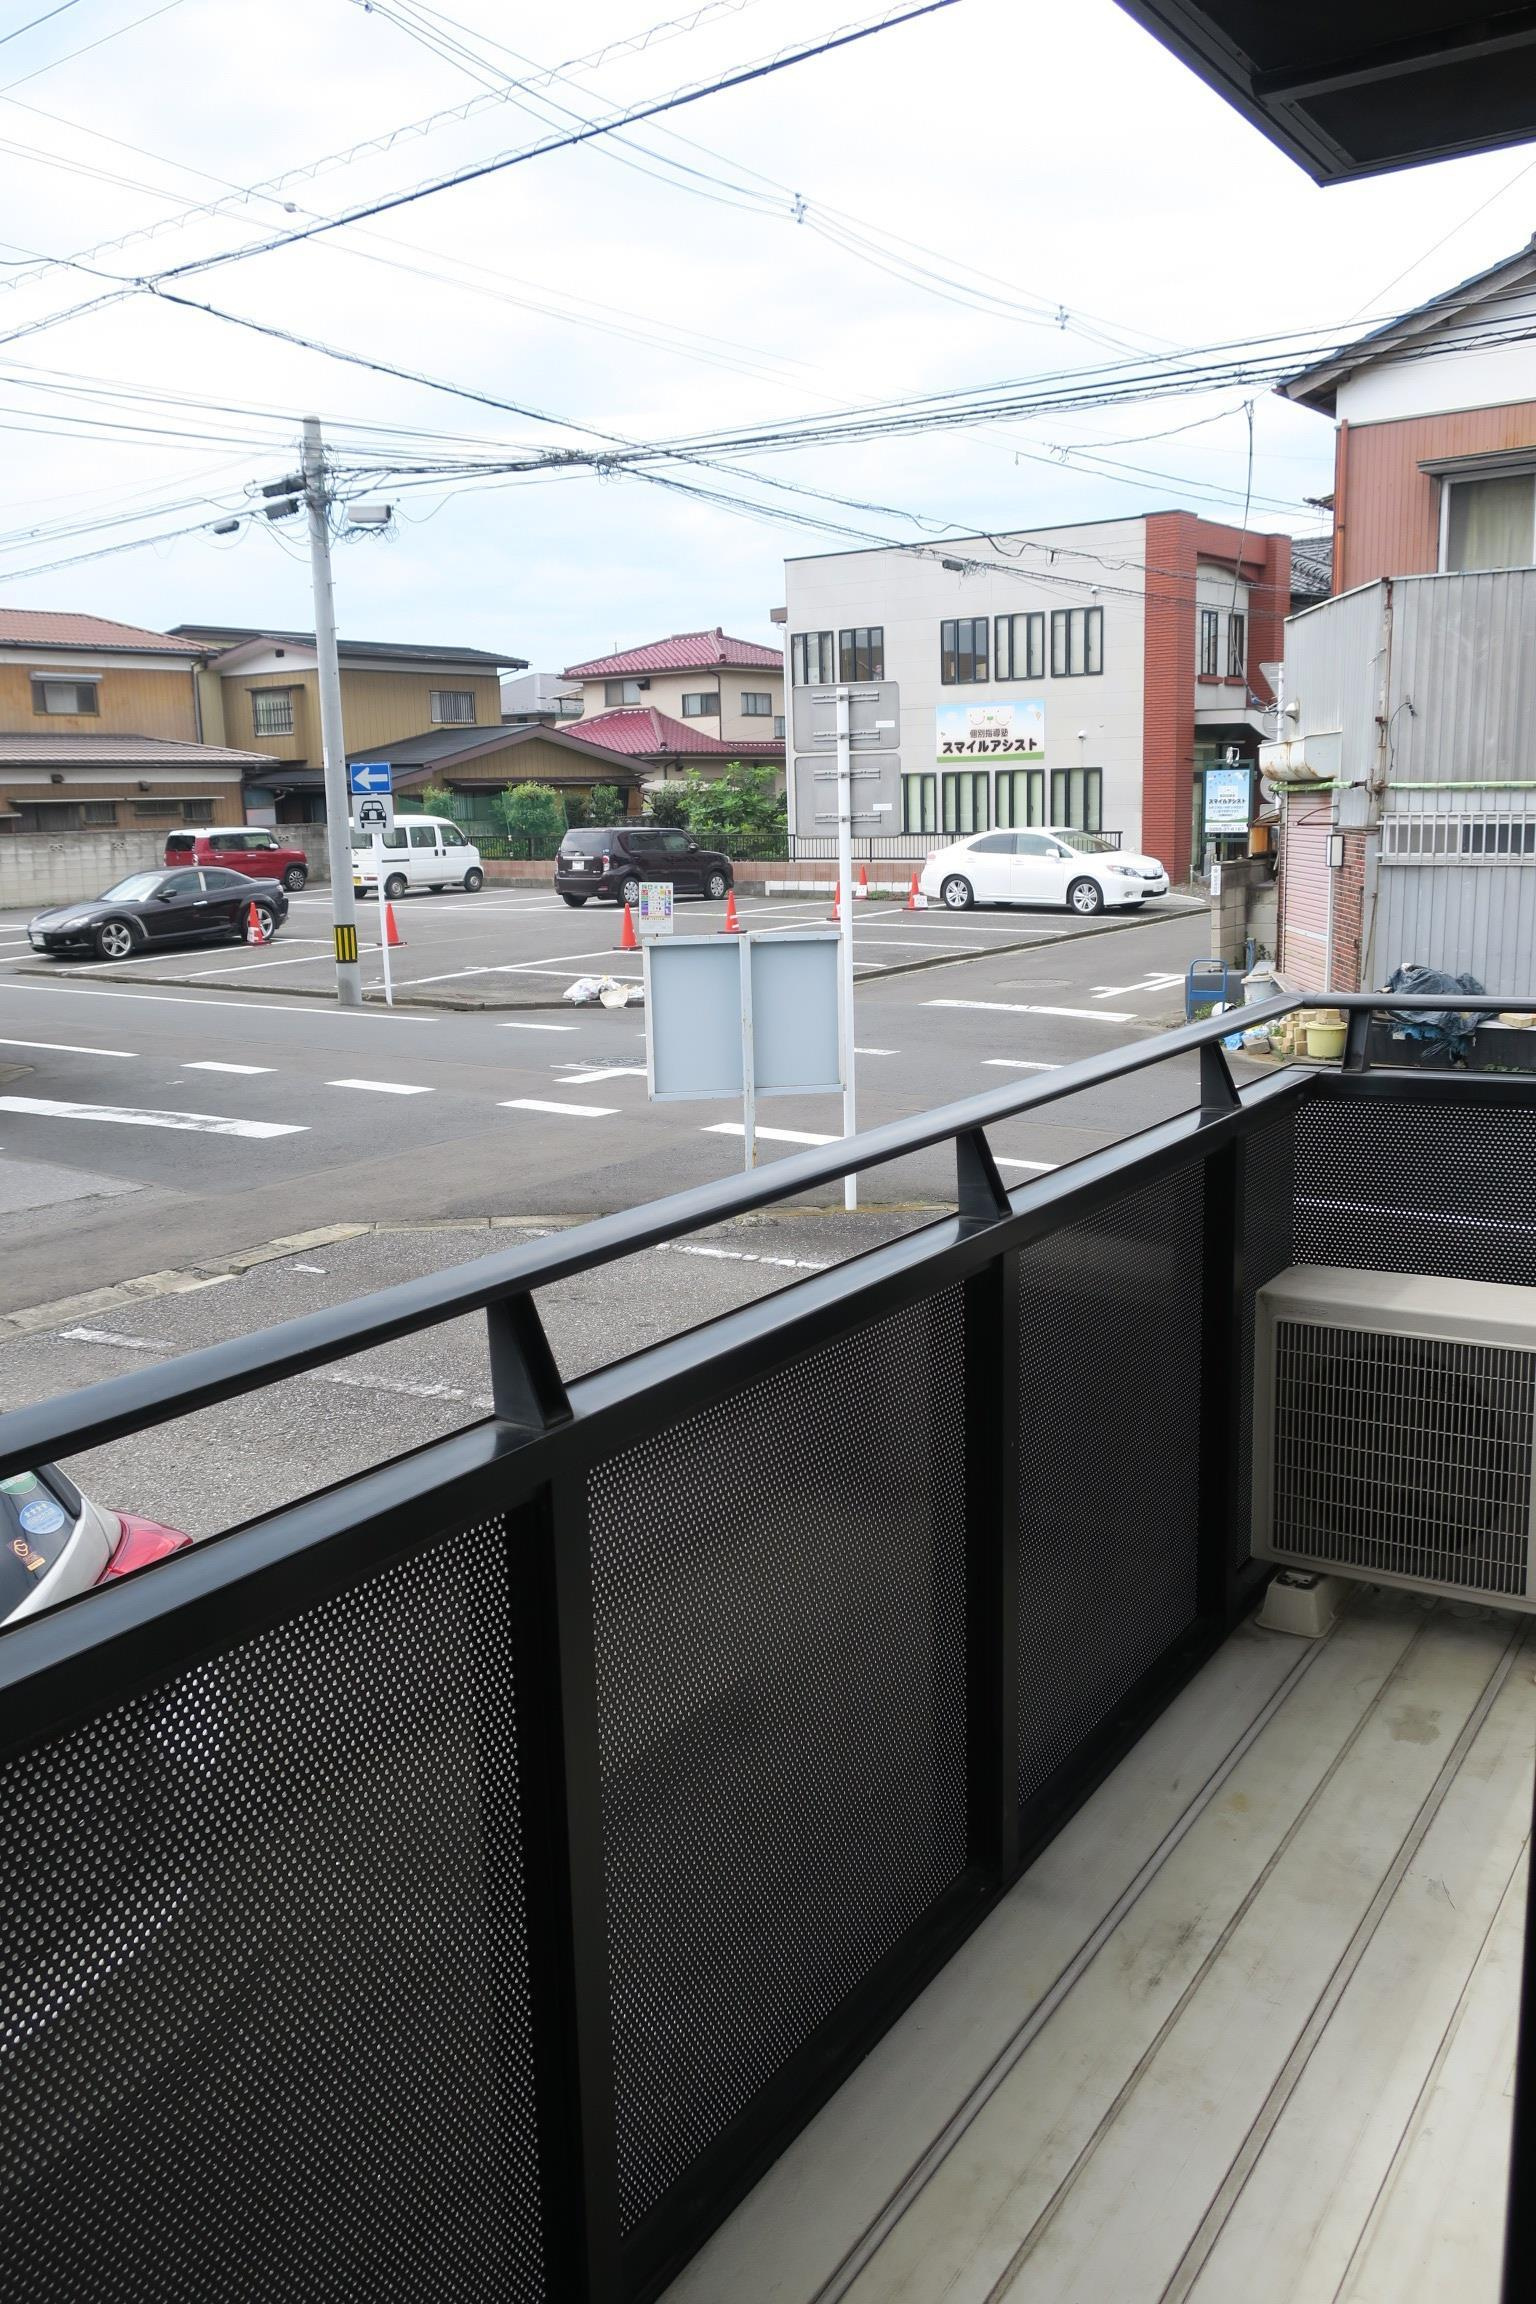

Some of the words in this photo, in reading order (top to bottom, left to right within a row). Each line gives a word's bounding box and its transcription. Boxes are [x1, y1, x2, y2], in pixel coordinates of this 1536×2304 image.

[970, 728, 1008, 738] 個別指導塾
[942, 738, 1038, 754] スマイルアシスト
